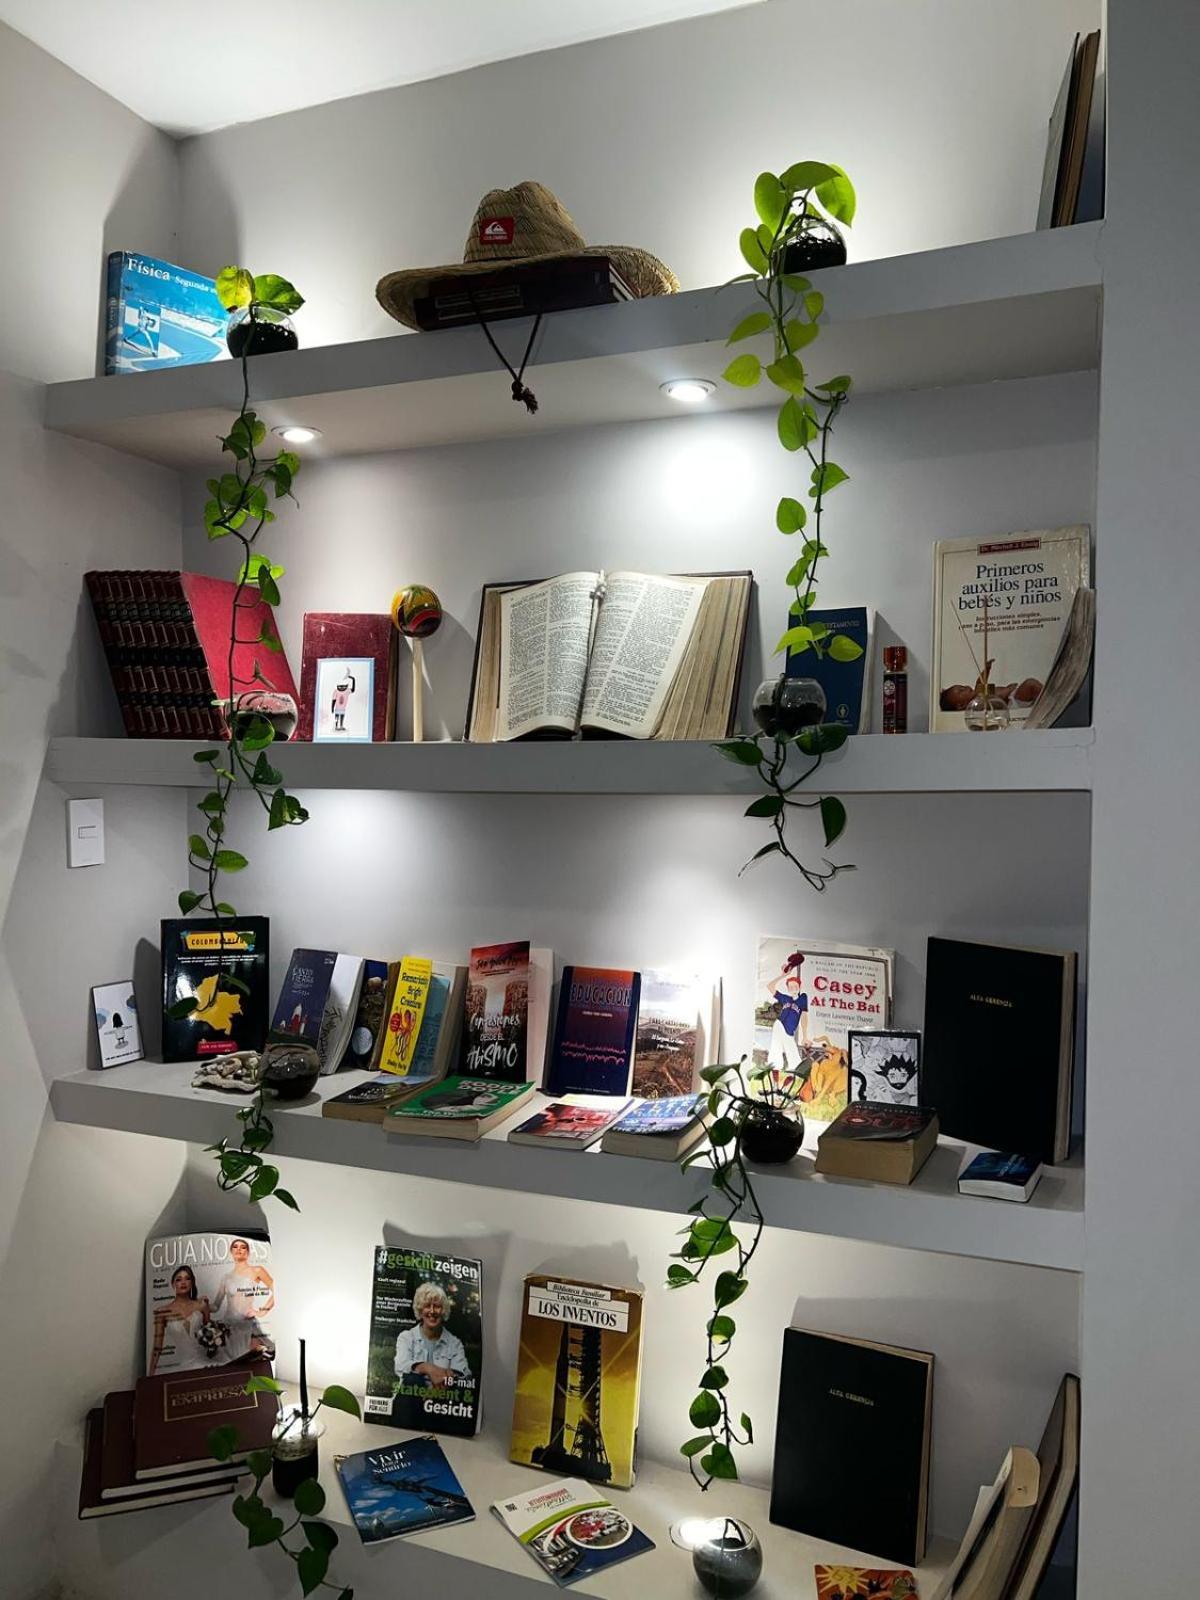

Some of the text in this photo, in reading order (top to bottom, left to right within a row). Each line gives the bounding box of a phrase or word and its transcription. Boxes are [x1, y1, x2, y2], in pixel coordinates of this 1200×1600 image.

[127, 258, 171, 281] Física
[976, 562, 1044, 579] Primeros
[962, 576, 1058, 595] auxilios para
[959, 590, 1062, 610] bebés y niños
[814, 975, 878, 1000] Casey
[810, 996, 881, 1013] At The Bat
[458, 1085, 521, 1095] DOYLE
[461, 1080, 527, 1091] RODDY
[150, 1237, 198, 1268] GUÍA
[378, 1250, 479, 1279] #gesichtzeigen
[553, 1284, 606, 1299] Biblioteca Familiar
[538, 1300, 617, 1328] LOS INVENTOS
[443, 1376, 476, 1388] 18-mal
[392, 1381, 474, 1403] Statement &
[423, 1399, 474, 1418] Gesicht
[368, 1450, 406, 1465] Vivir
